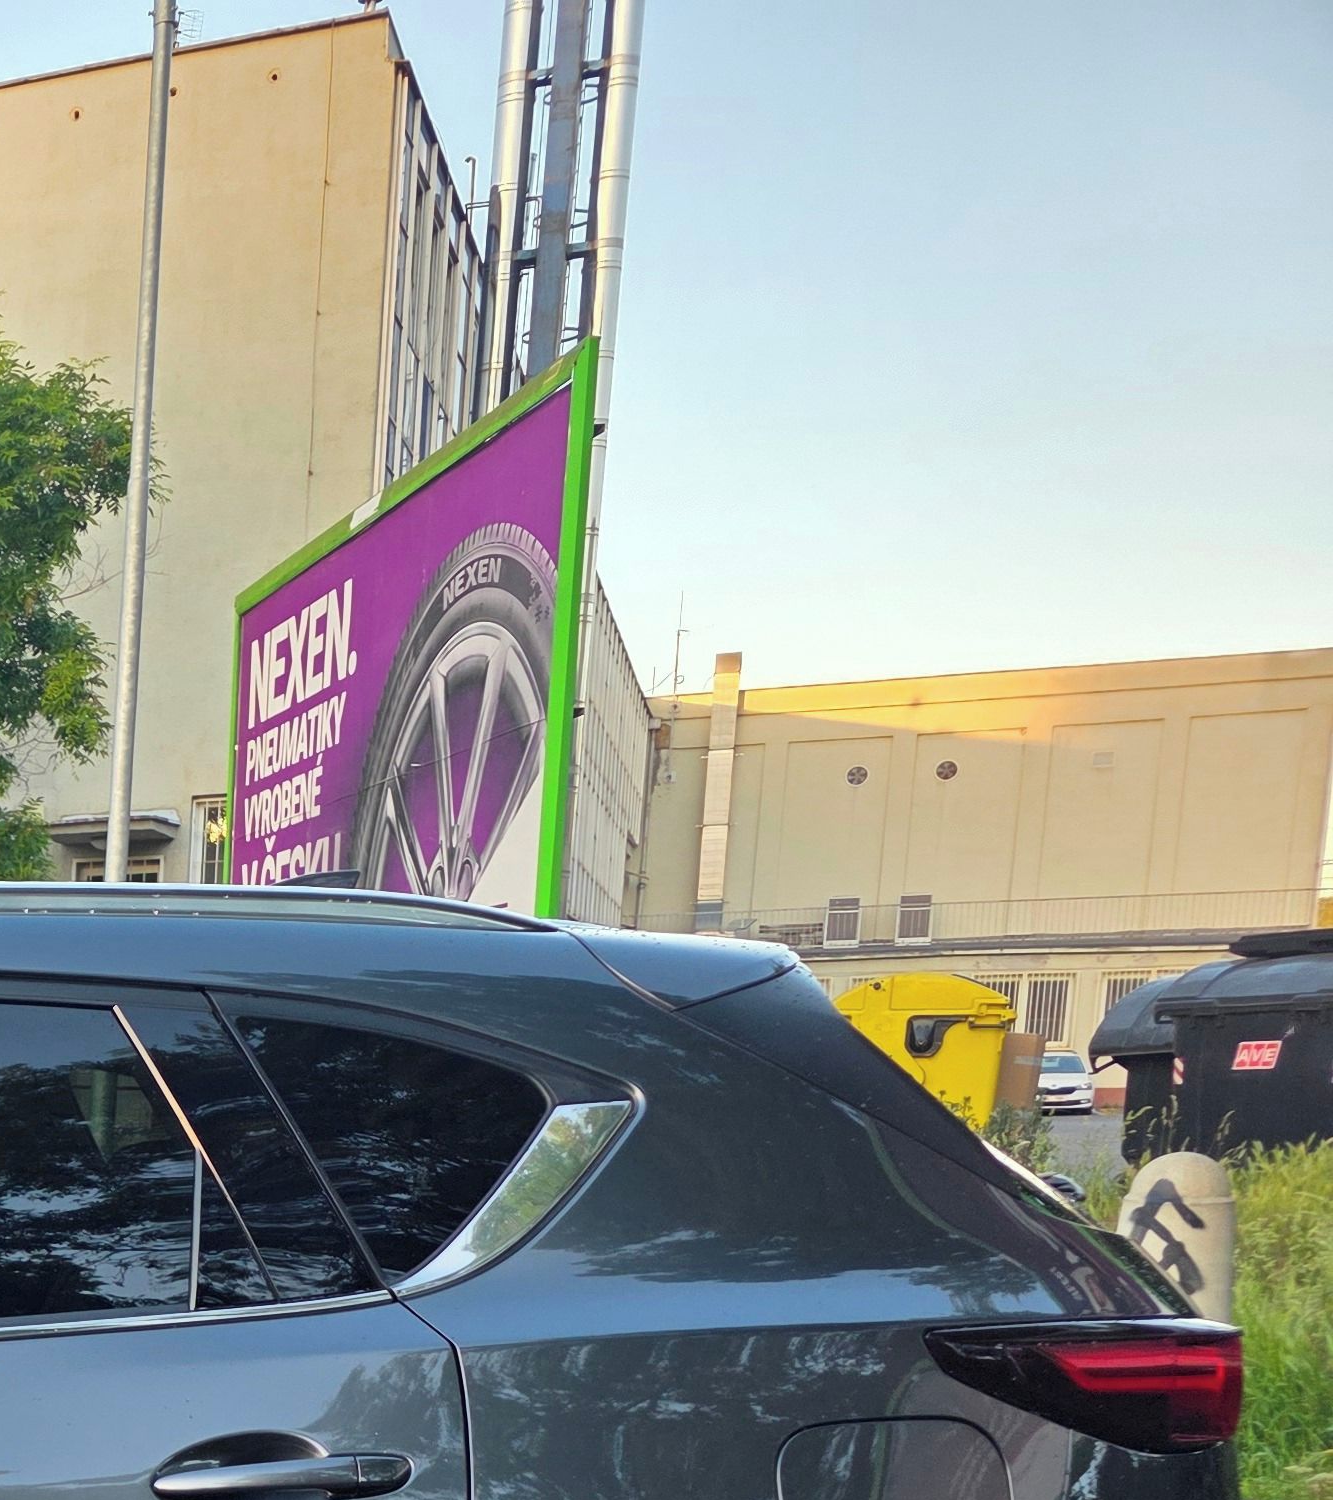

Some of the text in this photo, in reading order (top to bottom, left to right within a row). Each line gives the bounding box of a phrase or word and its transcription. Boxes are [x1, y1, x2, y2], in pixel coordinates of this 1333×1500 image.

[442, 557, 502, 611] NEXEN
[248, 578, 357, 730] NEXEN.
[245, 691, 346, 786] PNEUMATIKY
[244, 753, 323, 842] VYROBENÉ
[1237, 1047, 1277, 1064] AVE
